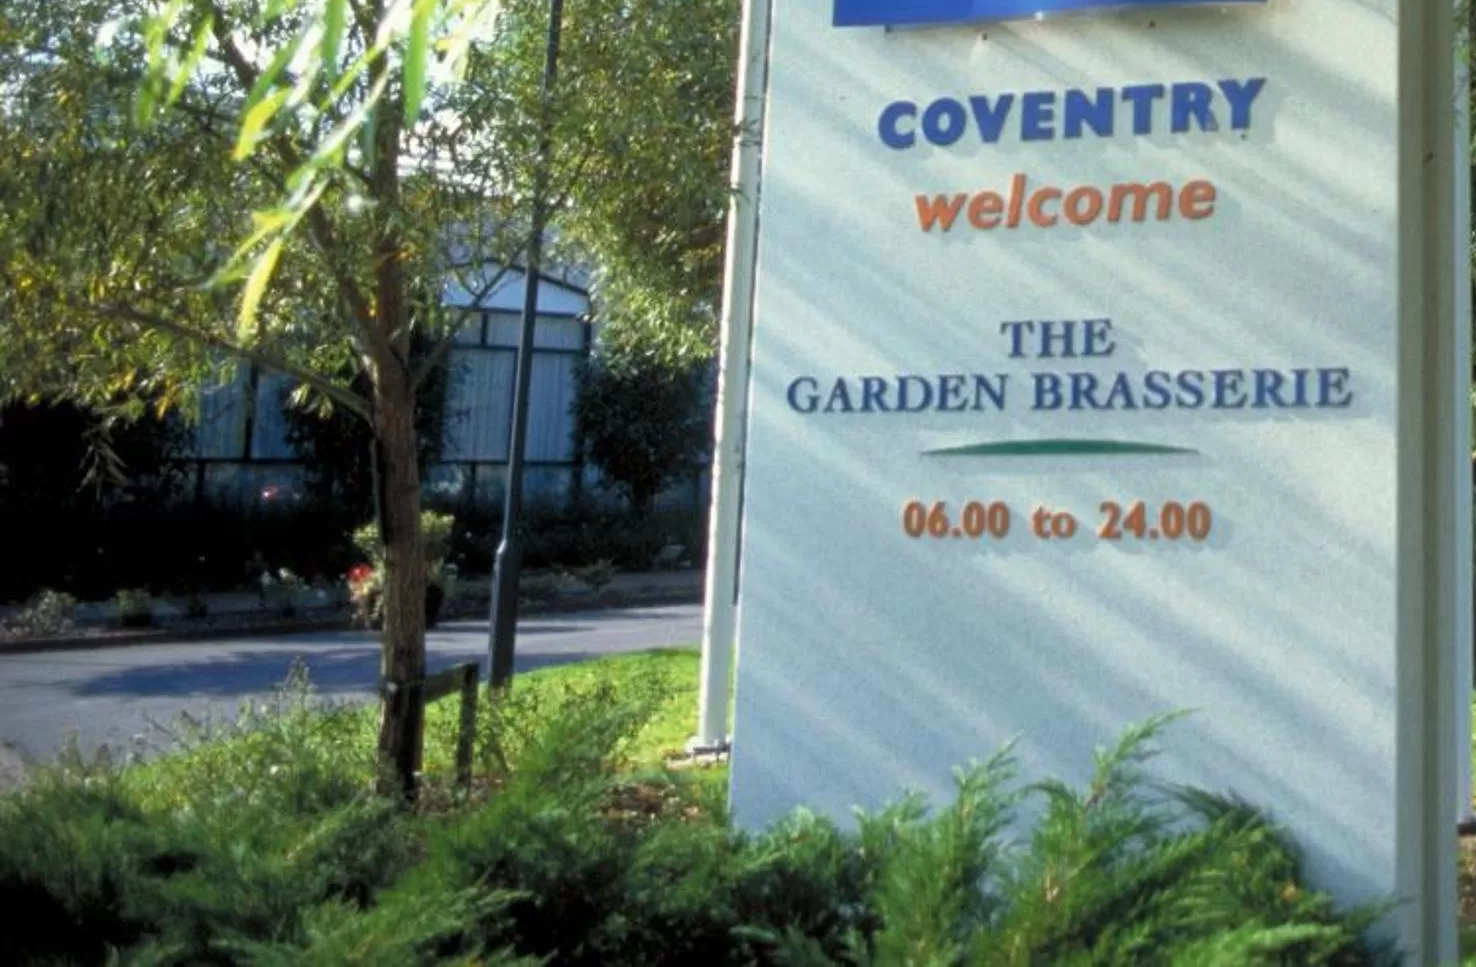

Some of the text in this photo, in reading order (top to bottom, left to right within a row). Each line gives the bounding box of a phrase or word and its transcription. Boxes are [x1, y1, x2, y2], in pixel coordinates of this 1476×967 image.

[878, 77, 1267, 149] COVENTRY
[914, 174, 1217, 233] welcome
[1001, 319, 1117, 359] THE
[786, 367, 1354, 414] GARDEN BRASSERIE
[903, 502, 1213, 541] 06.00 to 24.00
